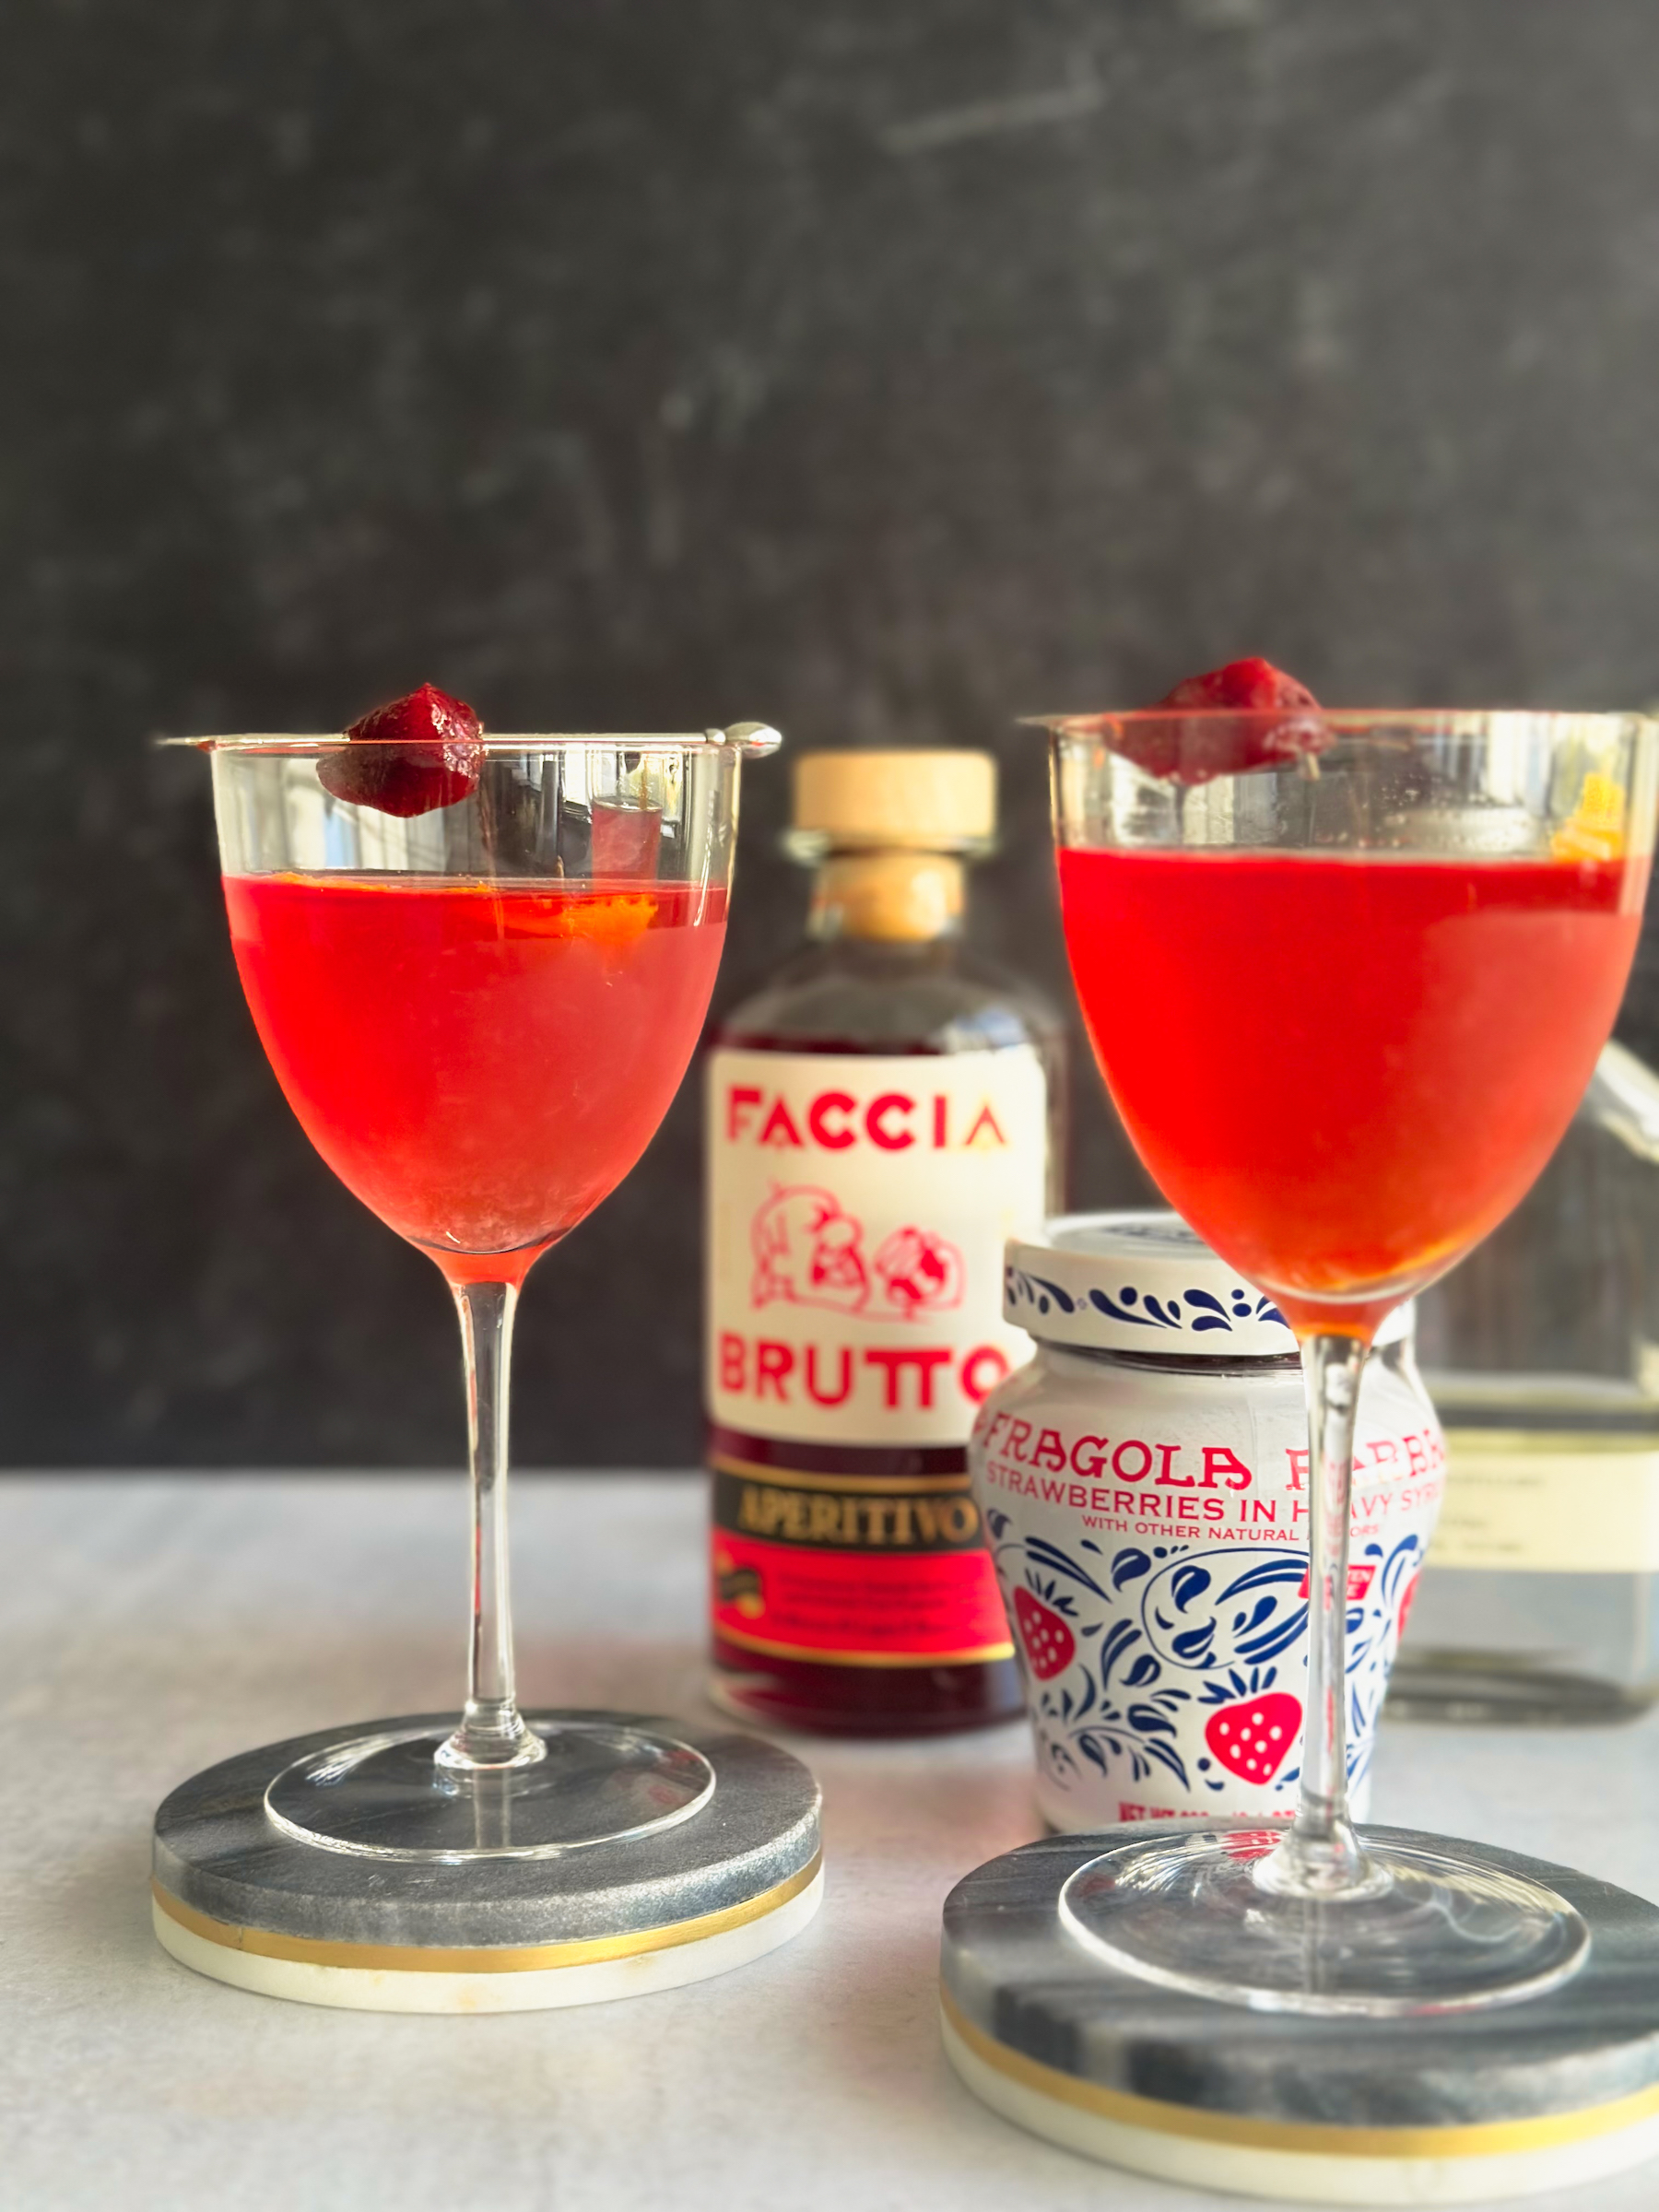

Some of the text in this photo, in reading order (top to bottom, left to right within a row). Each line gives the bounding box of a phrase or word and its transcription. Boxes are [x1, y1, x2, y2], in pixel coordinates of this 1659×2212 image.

[726, 1084, 1008, 1152] FACCIA
[718, 1329, 1012, 1412] BRUTTO
[982, 1409, 1253, 1491] FRAGOLA
[741, 1484, 980, 1546] APERITIVO
[985, 1460, 1226, 1522] STRAWBERRIES
[1240, 1499, 1277, 1524] IN
[1291, 1492, 1394, 1524] HVY
[1081, 1513, 1128, 1535] WITH
[1134, 1521, 1201, 1540] OTHER
[1207, 1526, 1300, 1542] NATURAL
